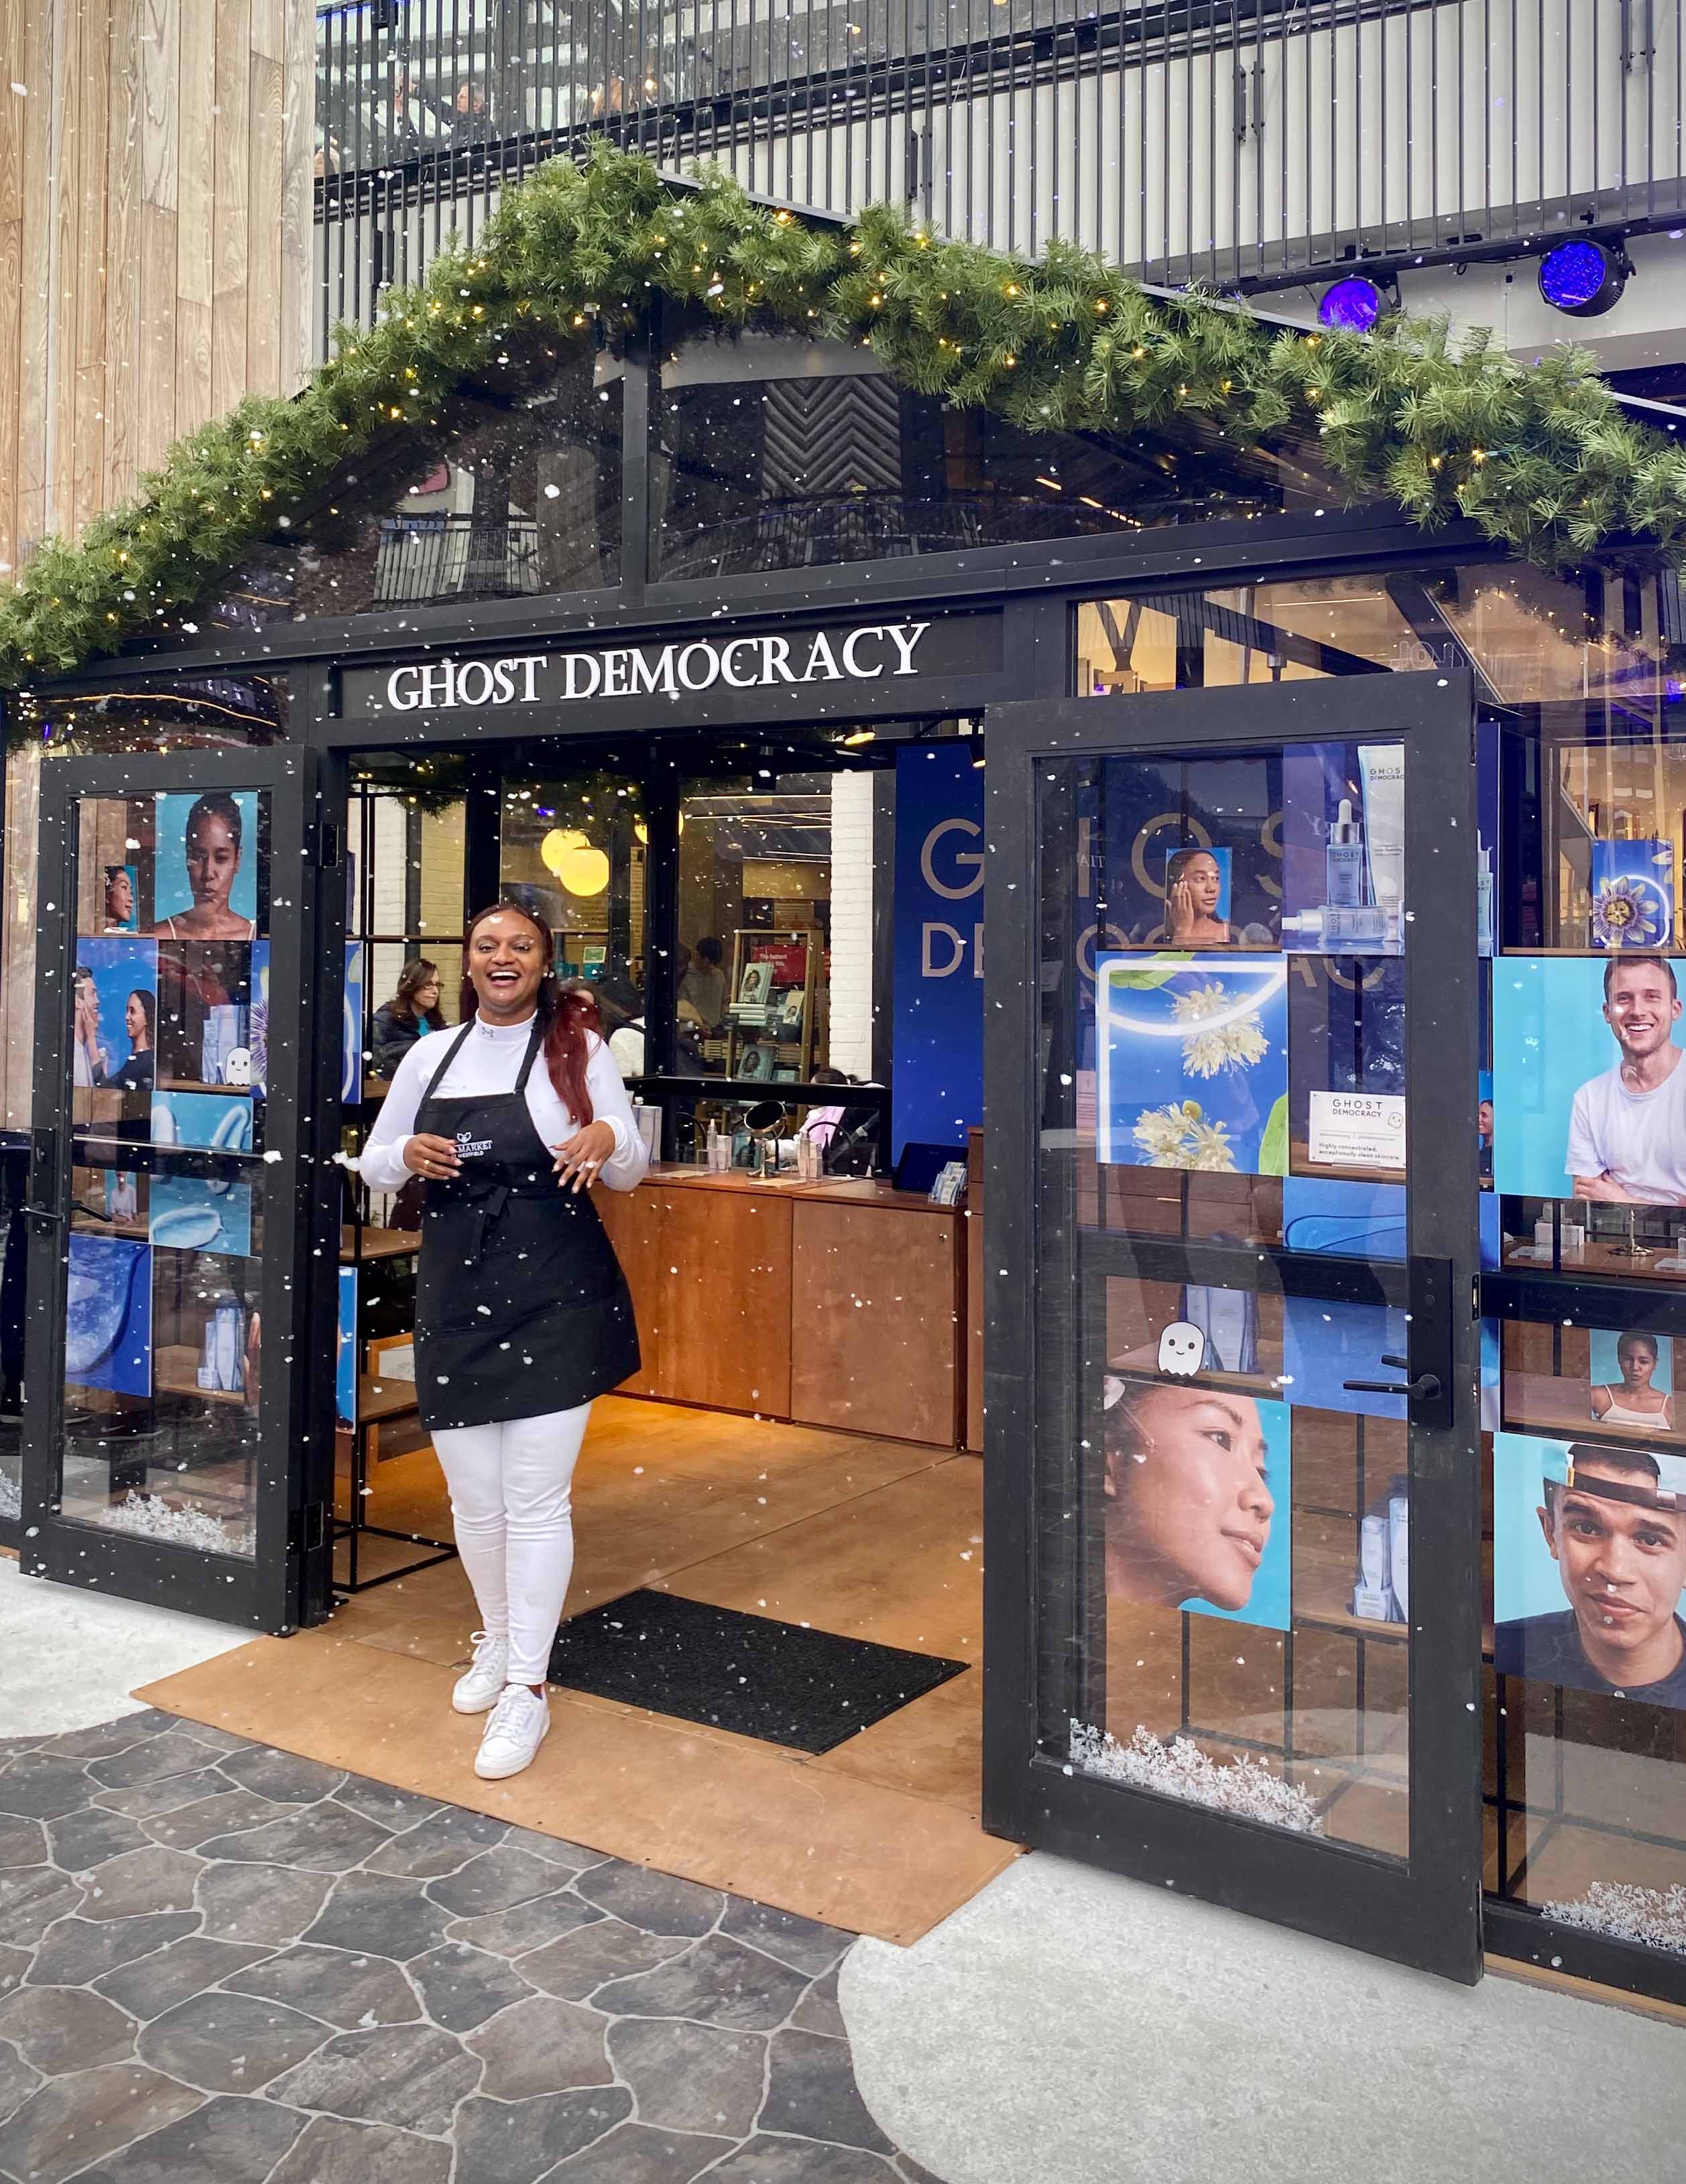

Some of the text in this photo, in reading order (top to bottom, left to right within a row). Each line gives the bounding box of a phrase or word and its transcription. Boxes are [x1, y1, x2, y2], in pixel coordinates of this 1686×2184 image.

[387, 622, 930, 709] GHOST DEMOCRACY
[1370, 767, 1400, 775] GHOS
[1333, 1099, 1382, 1109] GHOST
[1332, 1109, 1382, 1117] DEMOCRACY
